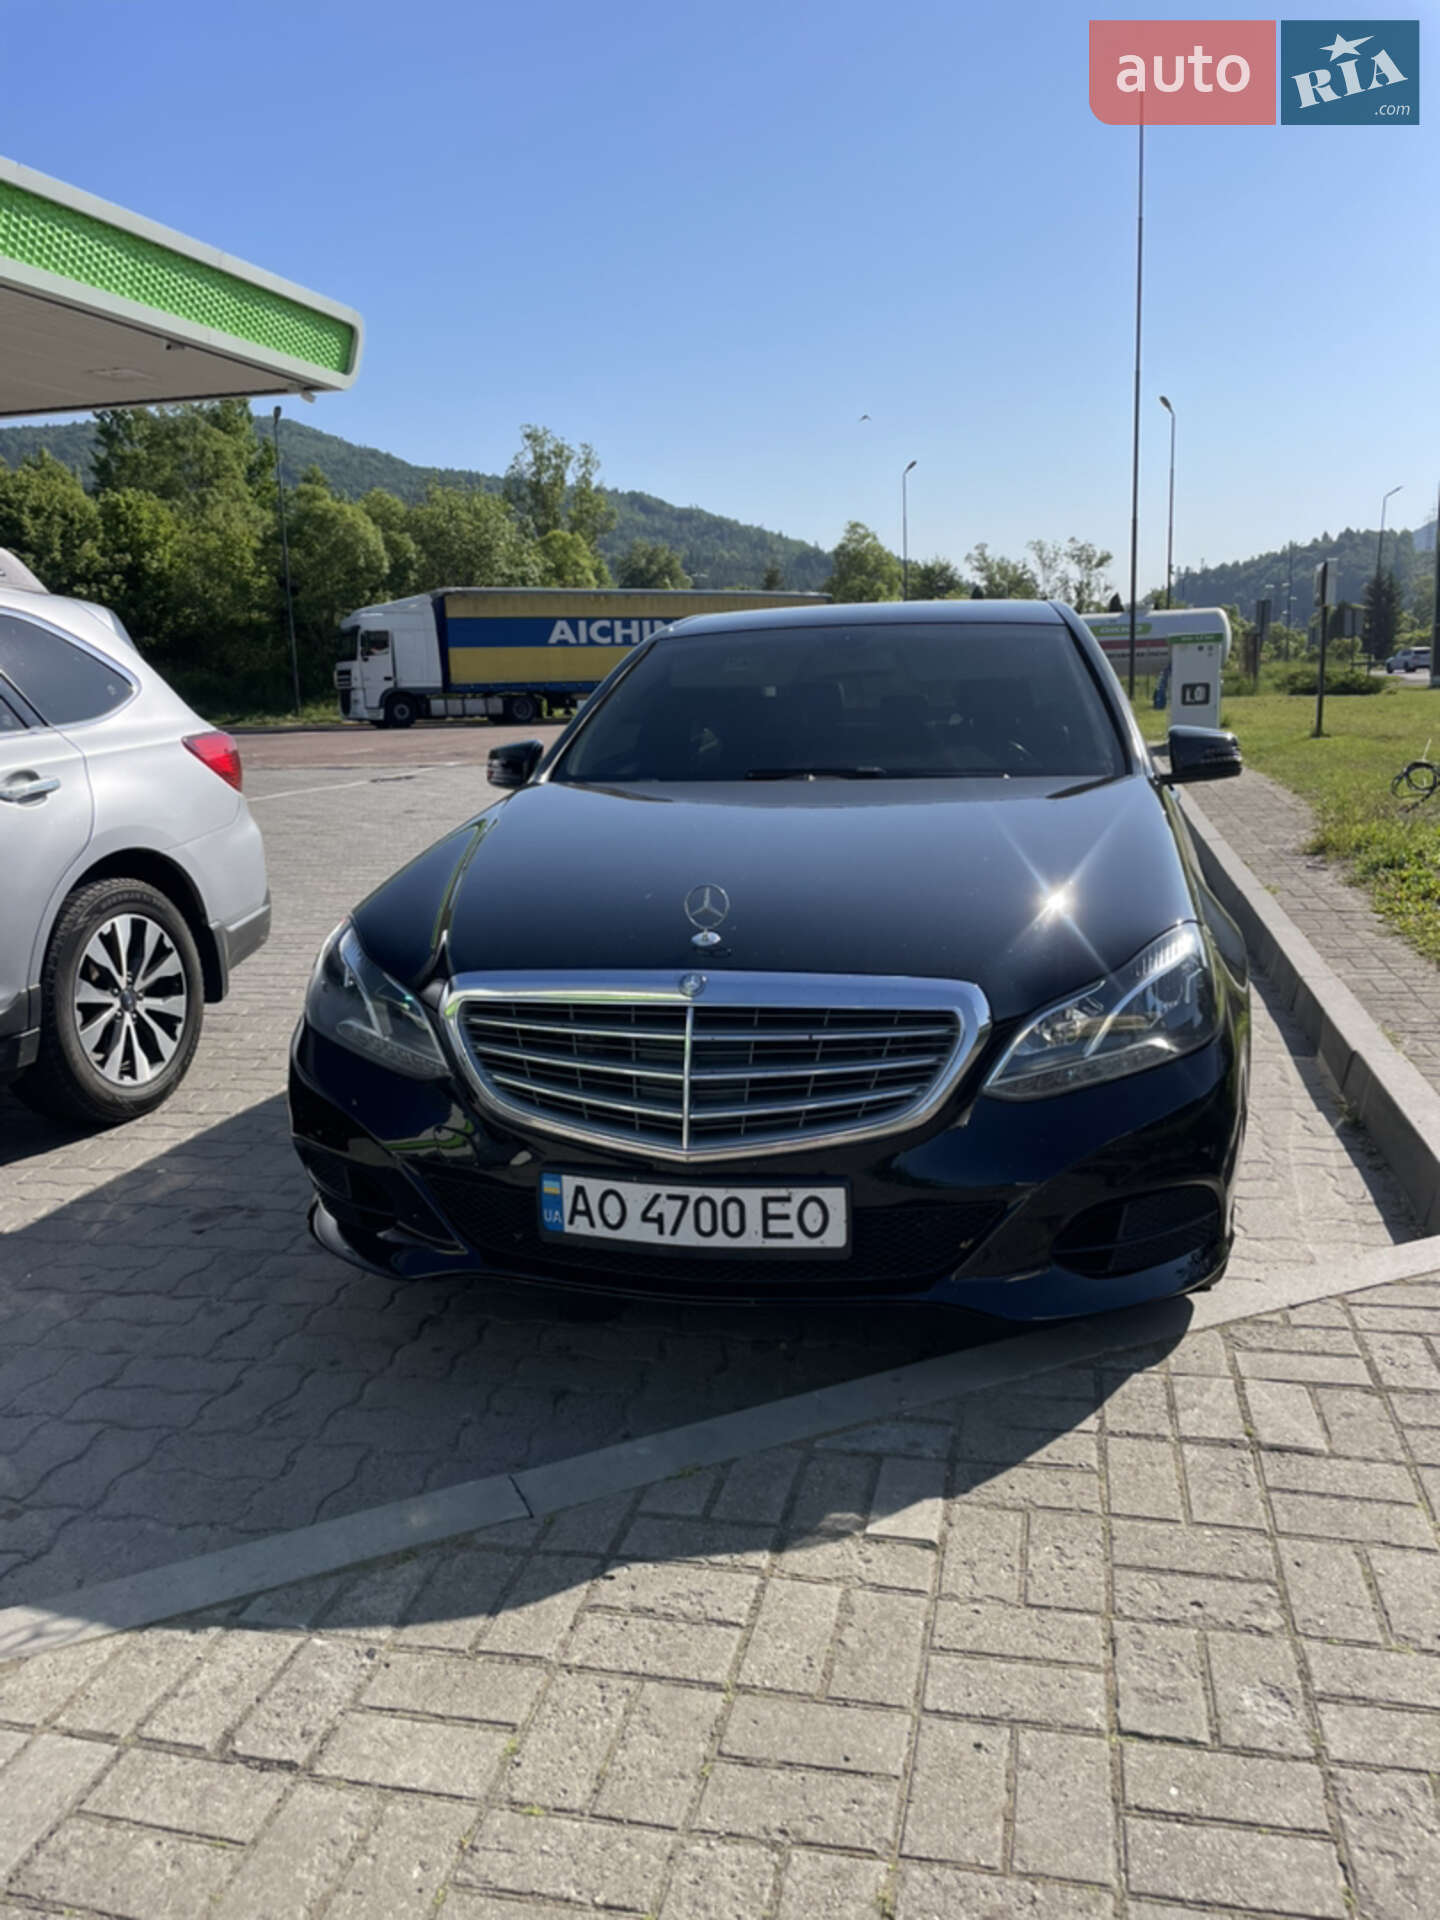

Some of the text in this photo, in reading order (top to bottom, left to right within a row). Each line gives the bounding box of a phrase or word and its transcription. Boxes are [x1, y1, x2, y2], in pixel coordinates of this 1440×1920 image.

[543, 1208, 562, 1223] UA
[567, 1185, 831, 1239] AO 4700 EO
